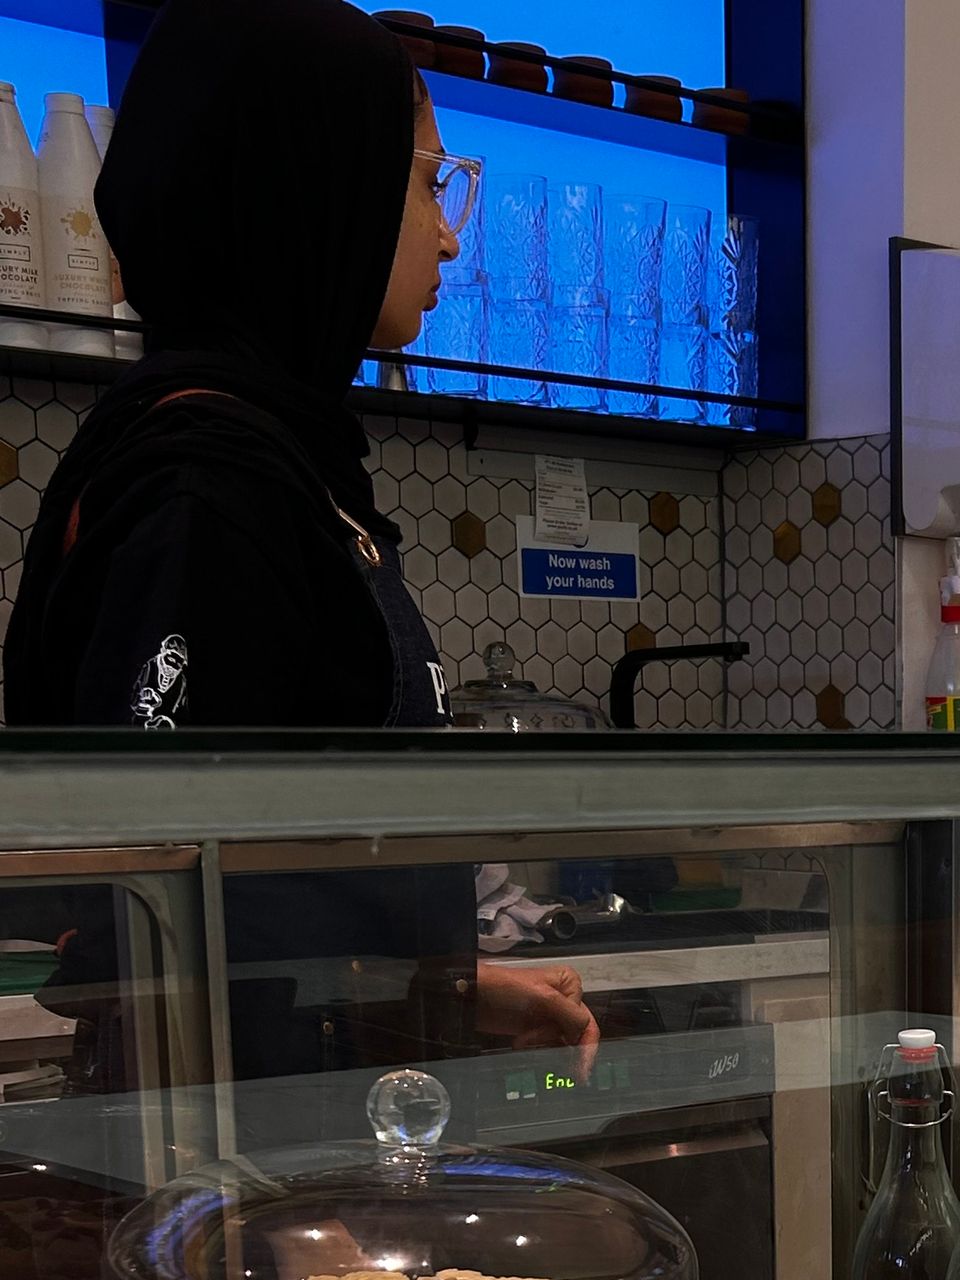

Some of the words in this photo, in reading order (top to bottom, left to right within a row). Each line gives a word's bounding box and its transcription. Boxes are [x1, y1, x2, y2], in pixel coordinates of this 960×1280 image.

[548, 554, 576, 569] Now
[579, 556, 611, 570] wash
[545, 575, 575, 590] your
[577, 574, 615, 590] hands
